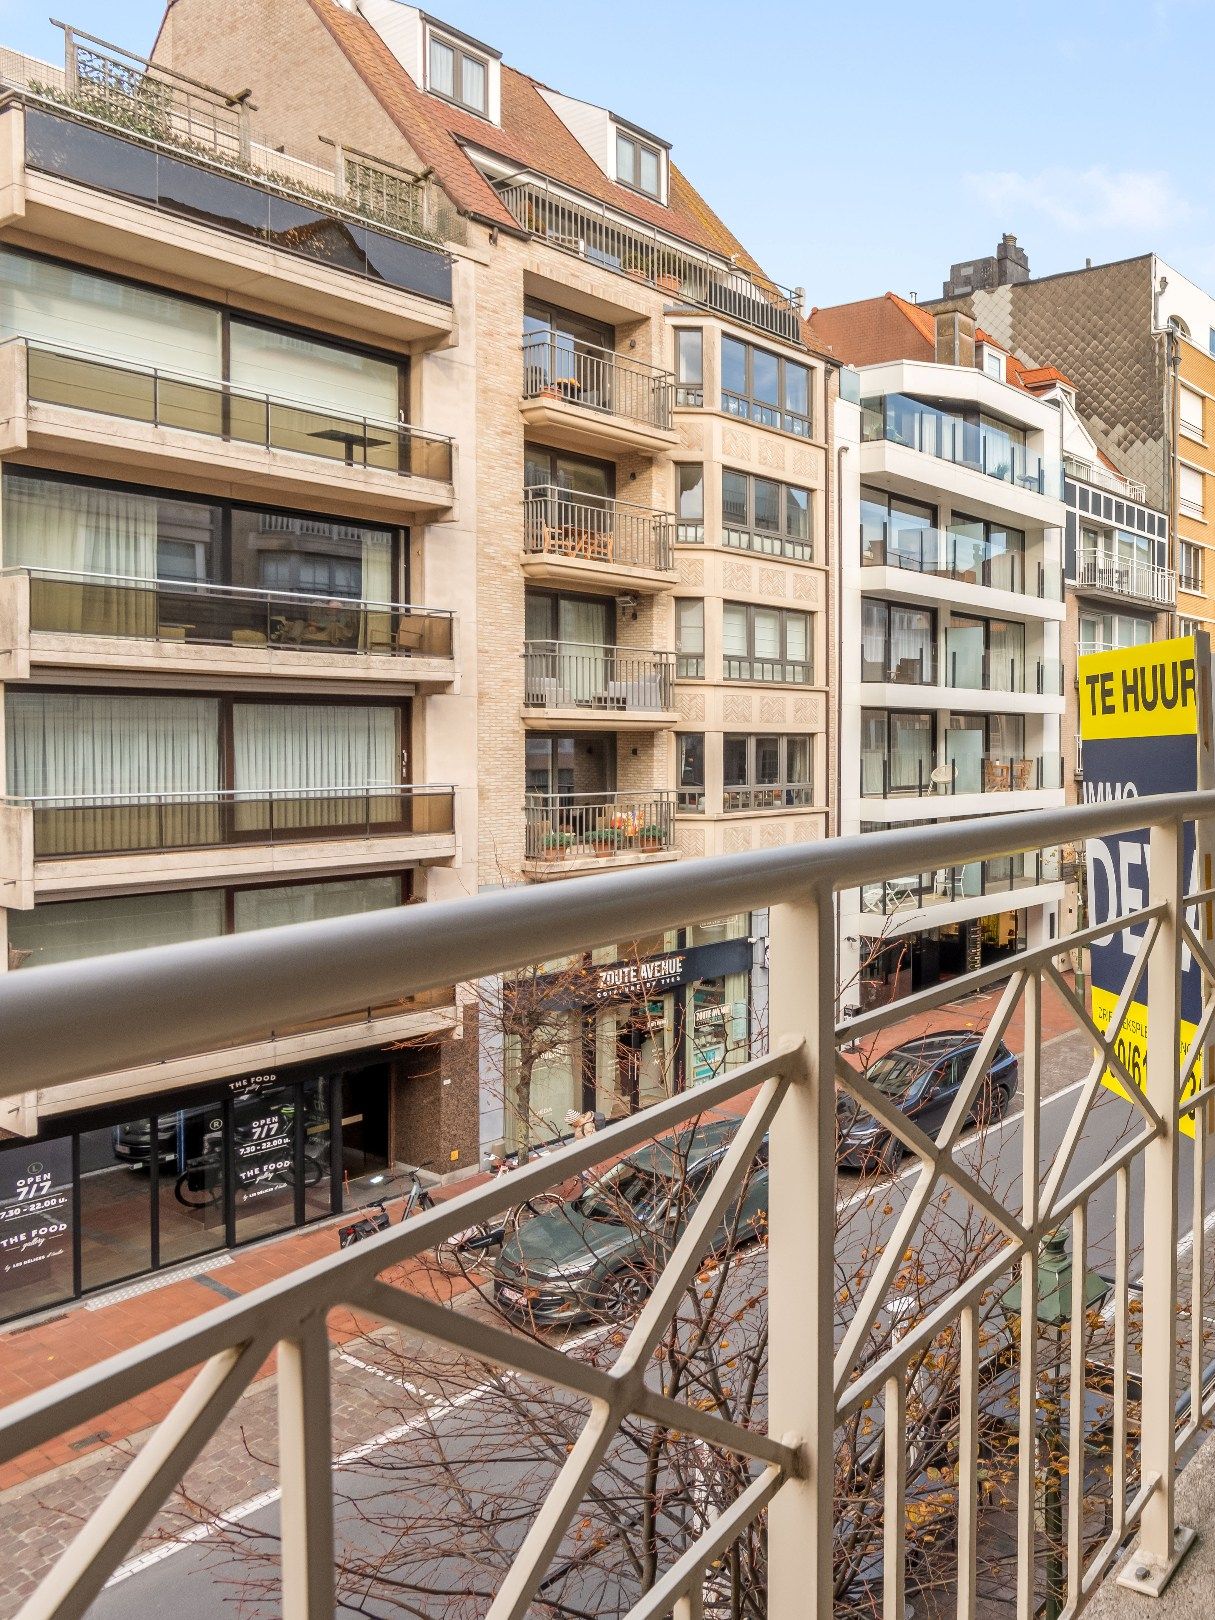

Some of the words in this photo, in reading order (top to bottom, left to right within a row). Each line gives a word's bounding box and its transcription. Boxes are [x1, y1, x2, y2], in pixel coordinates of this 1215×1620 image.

[1085, 671, 1116, 716] TE
[1121, 658, 1197, 713] HUUR
[599, 965, 638, 988] ZOUTE
[640, 958, 683, 979] AVENUE
[229, 1079, 248, 1090] THE
[250, 1074, 277, 1084] FOOD
[252, 1115, 279, 1128] OPEN
[252, 1122, 279, 1140] 7/7
[239, 1145, 256, 1155] 7.30
[262, 1137, 283, 1149] 22.00
[16, 1172, 51, 1187] OPEN
[239, 1167, 260, 1180] THE
[263, 1160, 291, 1172] FOOD
[16, 1180, 52, 1201] 7/7
[0, 1207, 21, 1220] 7.30
[29, 1198, 57, 1212] 22.00
[0, 1232, 27, 1248] THE
[31, 1223, 68, 1238] FOOD
